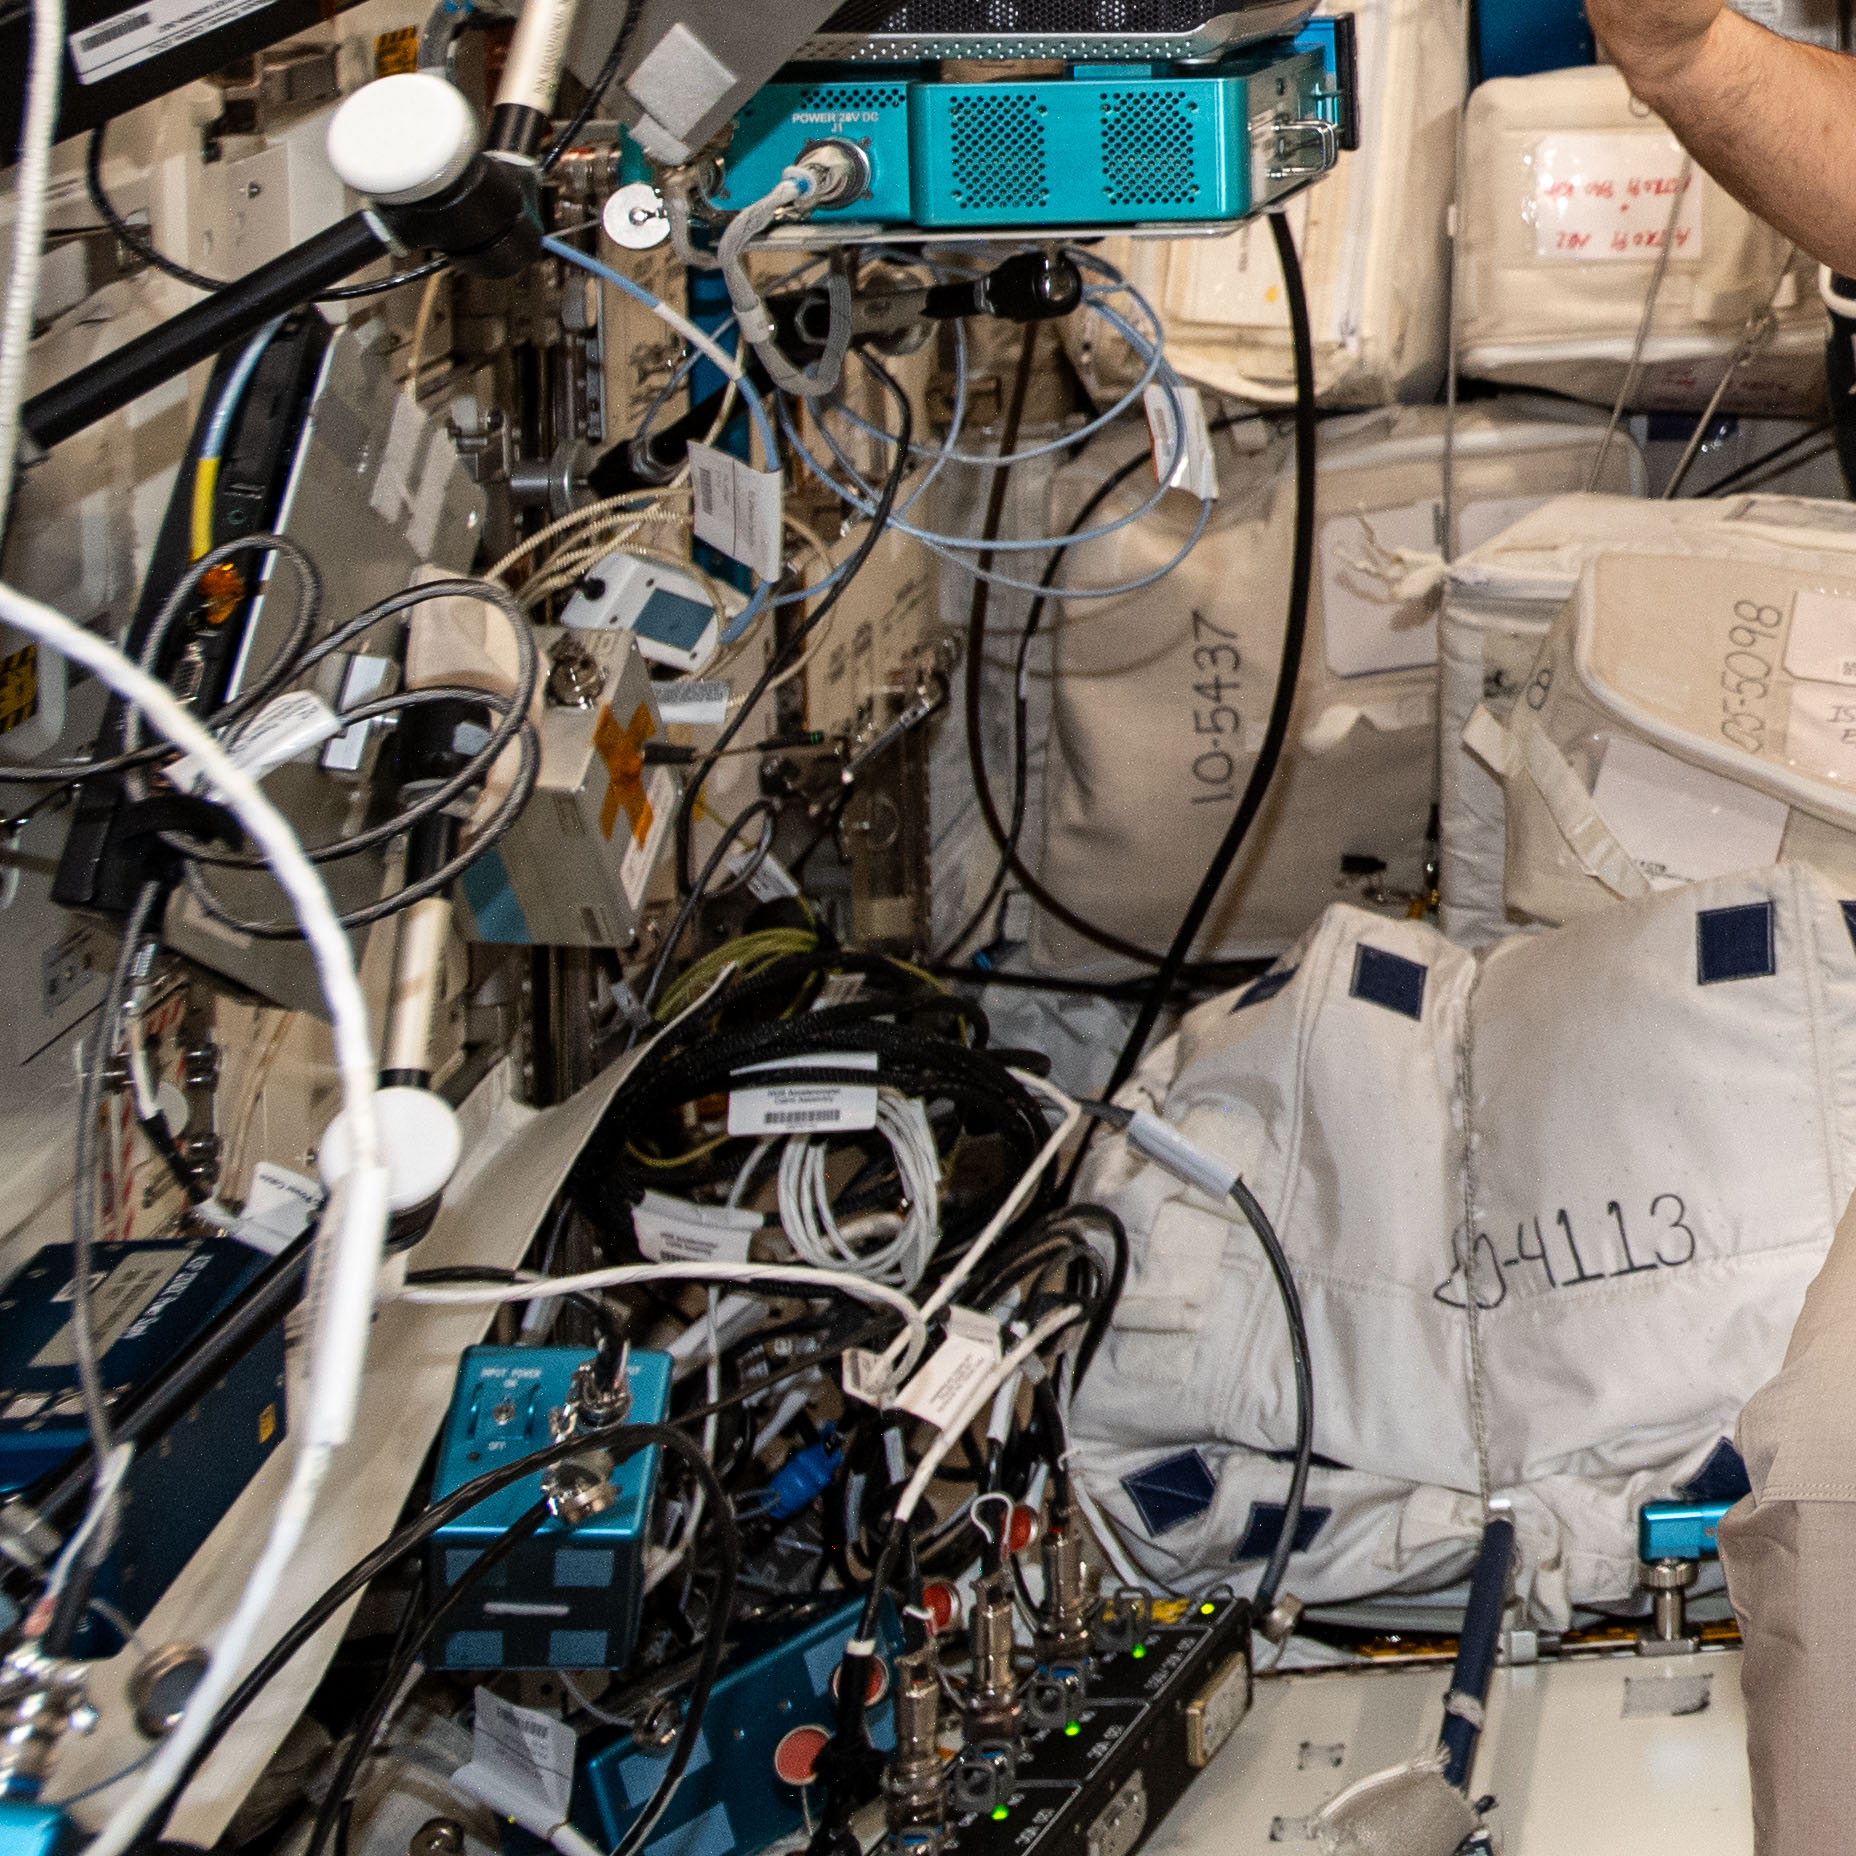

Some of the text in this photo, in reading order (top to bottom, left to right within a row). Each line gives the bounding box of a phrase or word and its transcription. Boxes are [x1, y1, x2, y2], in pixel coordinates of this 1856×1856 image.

[792, 113, 879, 123] POWER 28V DC
[831, 123, 843, 132] J1
[480, 1364, 542, 1381] INPUT POWER
